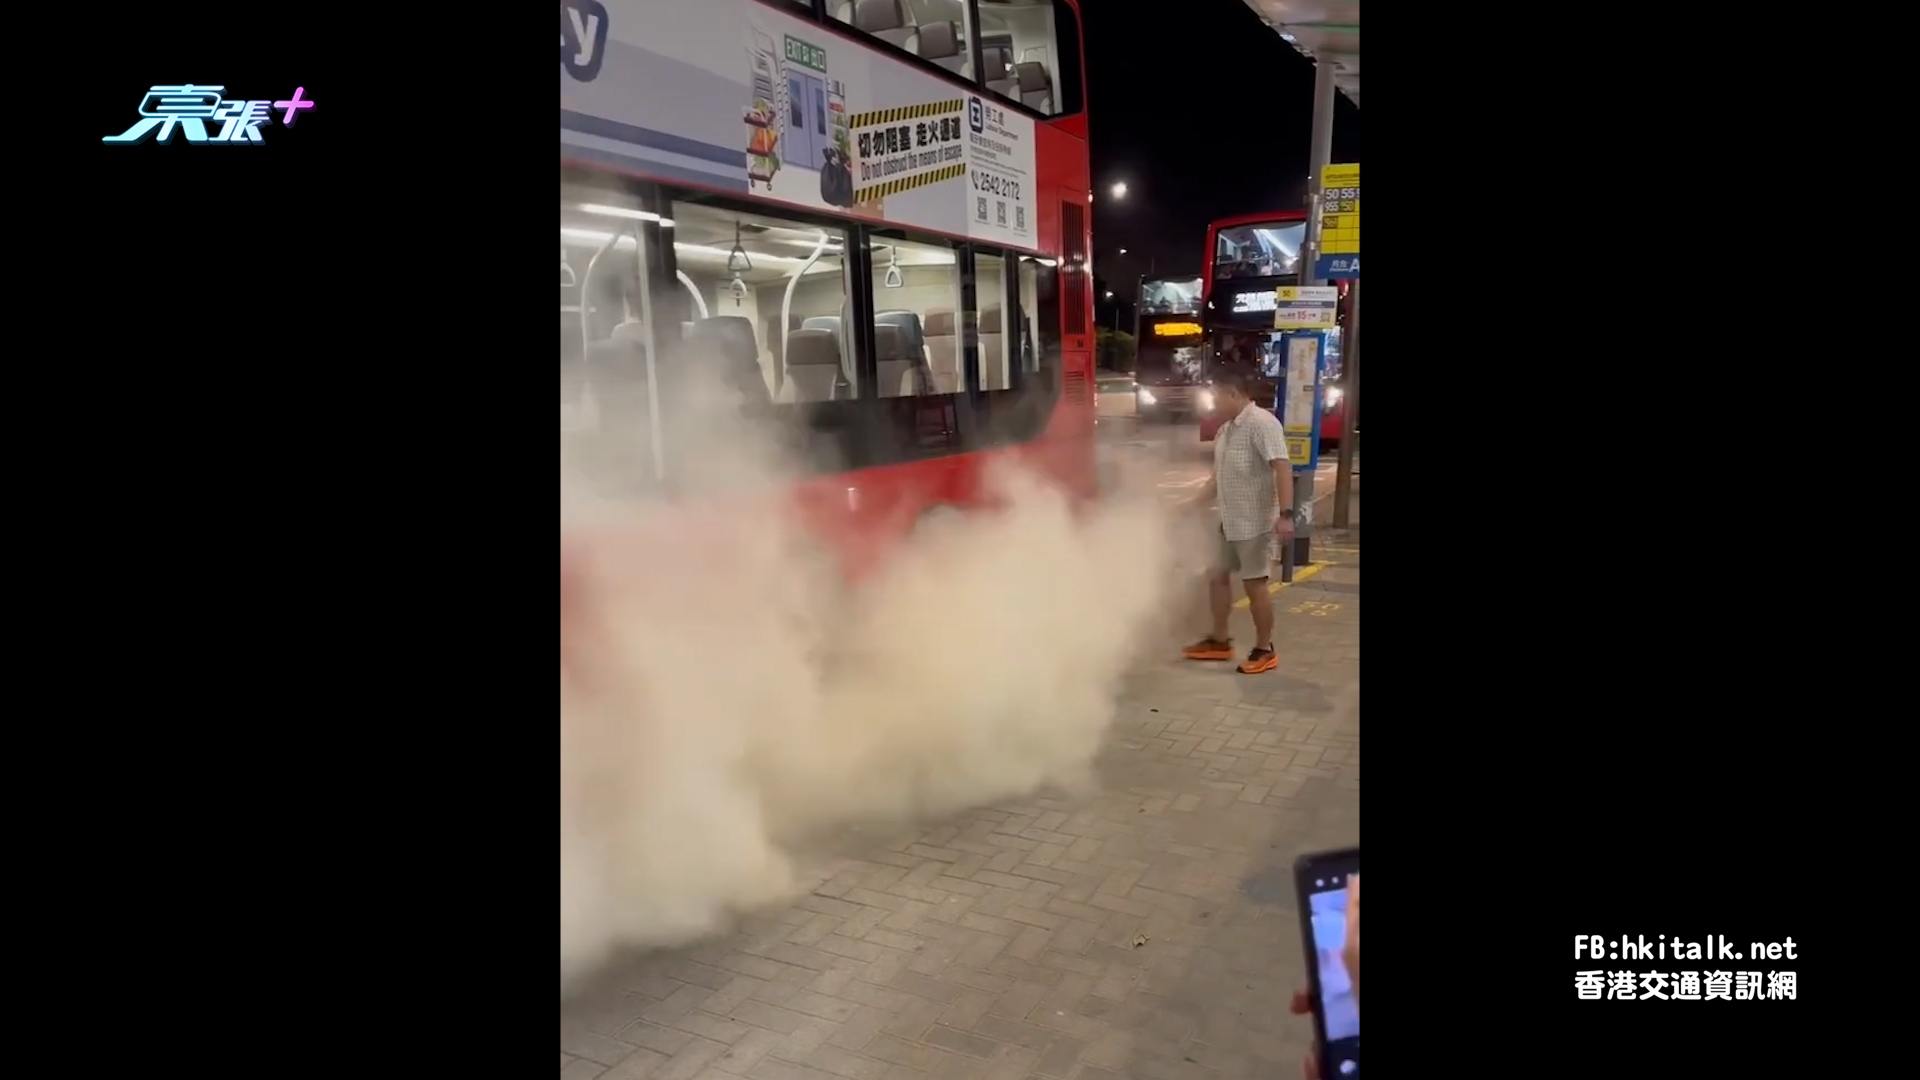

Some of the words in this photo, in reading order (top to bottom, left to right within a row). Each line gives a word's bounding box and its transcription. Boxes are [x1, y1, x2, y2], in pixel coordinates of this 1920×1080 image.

[561, 7, 599, 66] y
[786, 37, 802, 61] EXIT
[810, 48, 825, 69] 出口
[857, 125, 911, 158] 切勿阻塞
[916, 116, 962, 147] 走火通道
[860, 161, 871, 182] Do
[871, 158, 883, 180] not
[883, 154, 908, 177] obstruct
[907, 152, 918, 170] the
[918, 149, 938, 167] means
[938, 144, 945, 163] of
[944, 143, 963, 163] escape
[980, 172, 1000, 196] 2542
[1001, 180, 1020, 201] 2172
[1325, 188, 1339, 199] 50
[1340, 187, 1355, 199] 55
[1324, 200, 1339, 213] 955
[1349, 257, 1360, 272] A
[1297, 310, 1307, 320] 15
